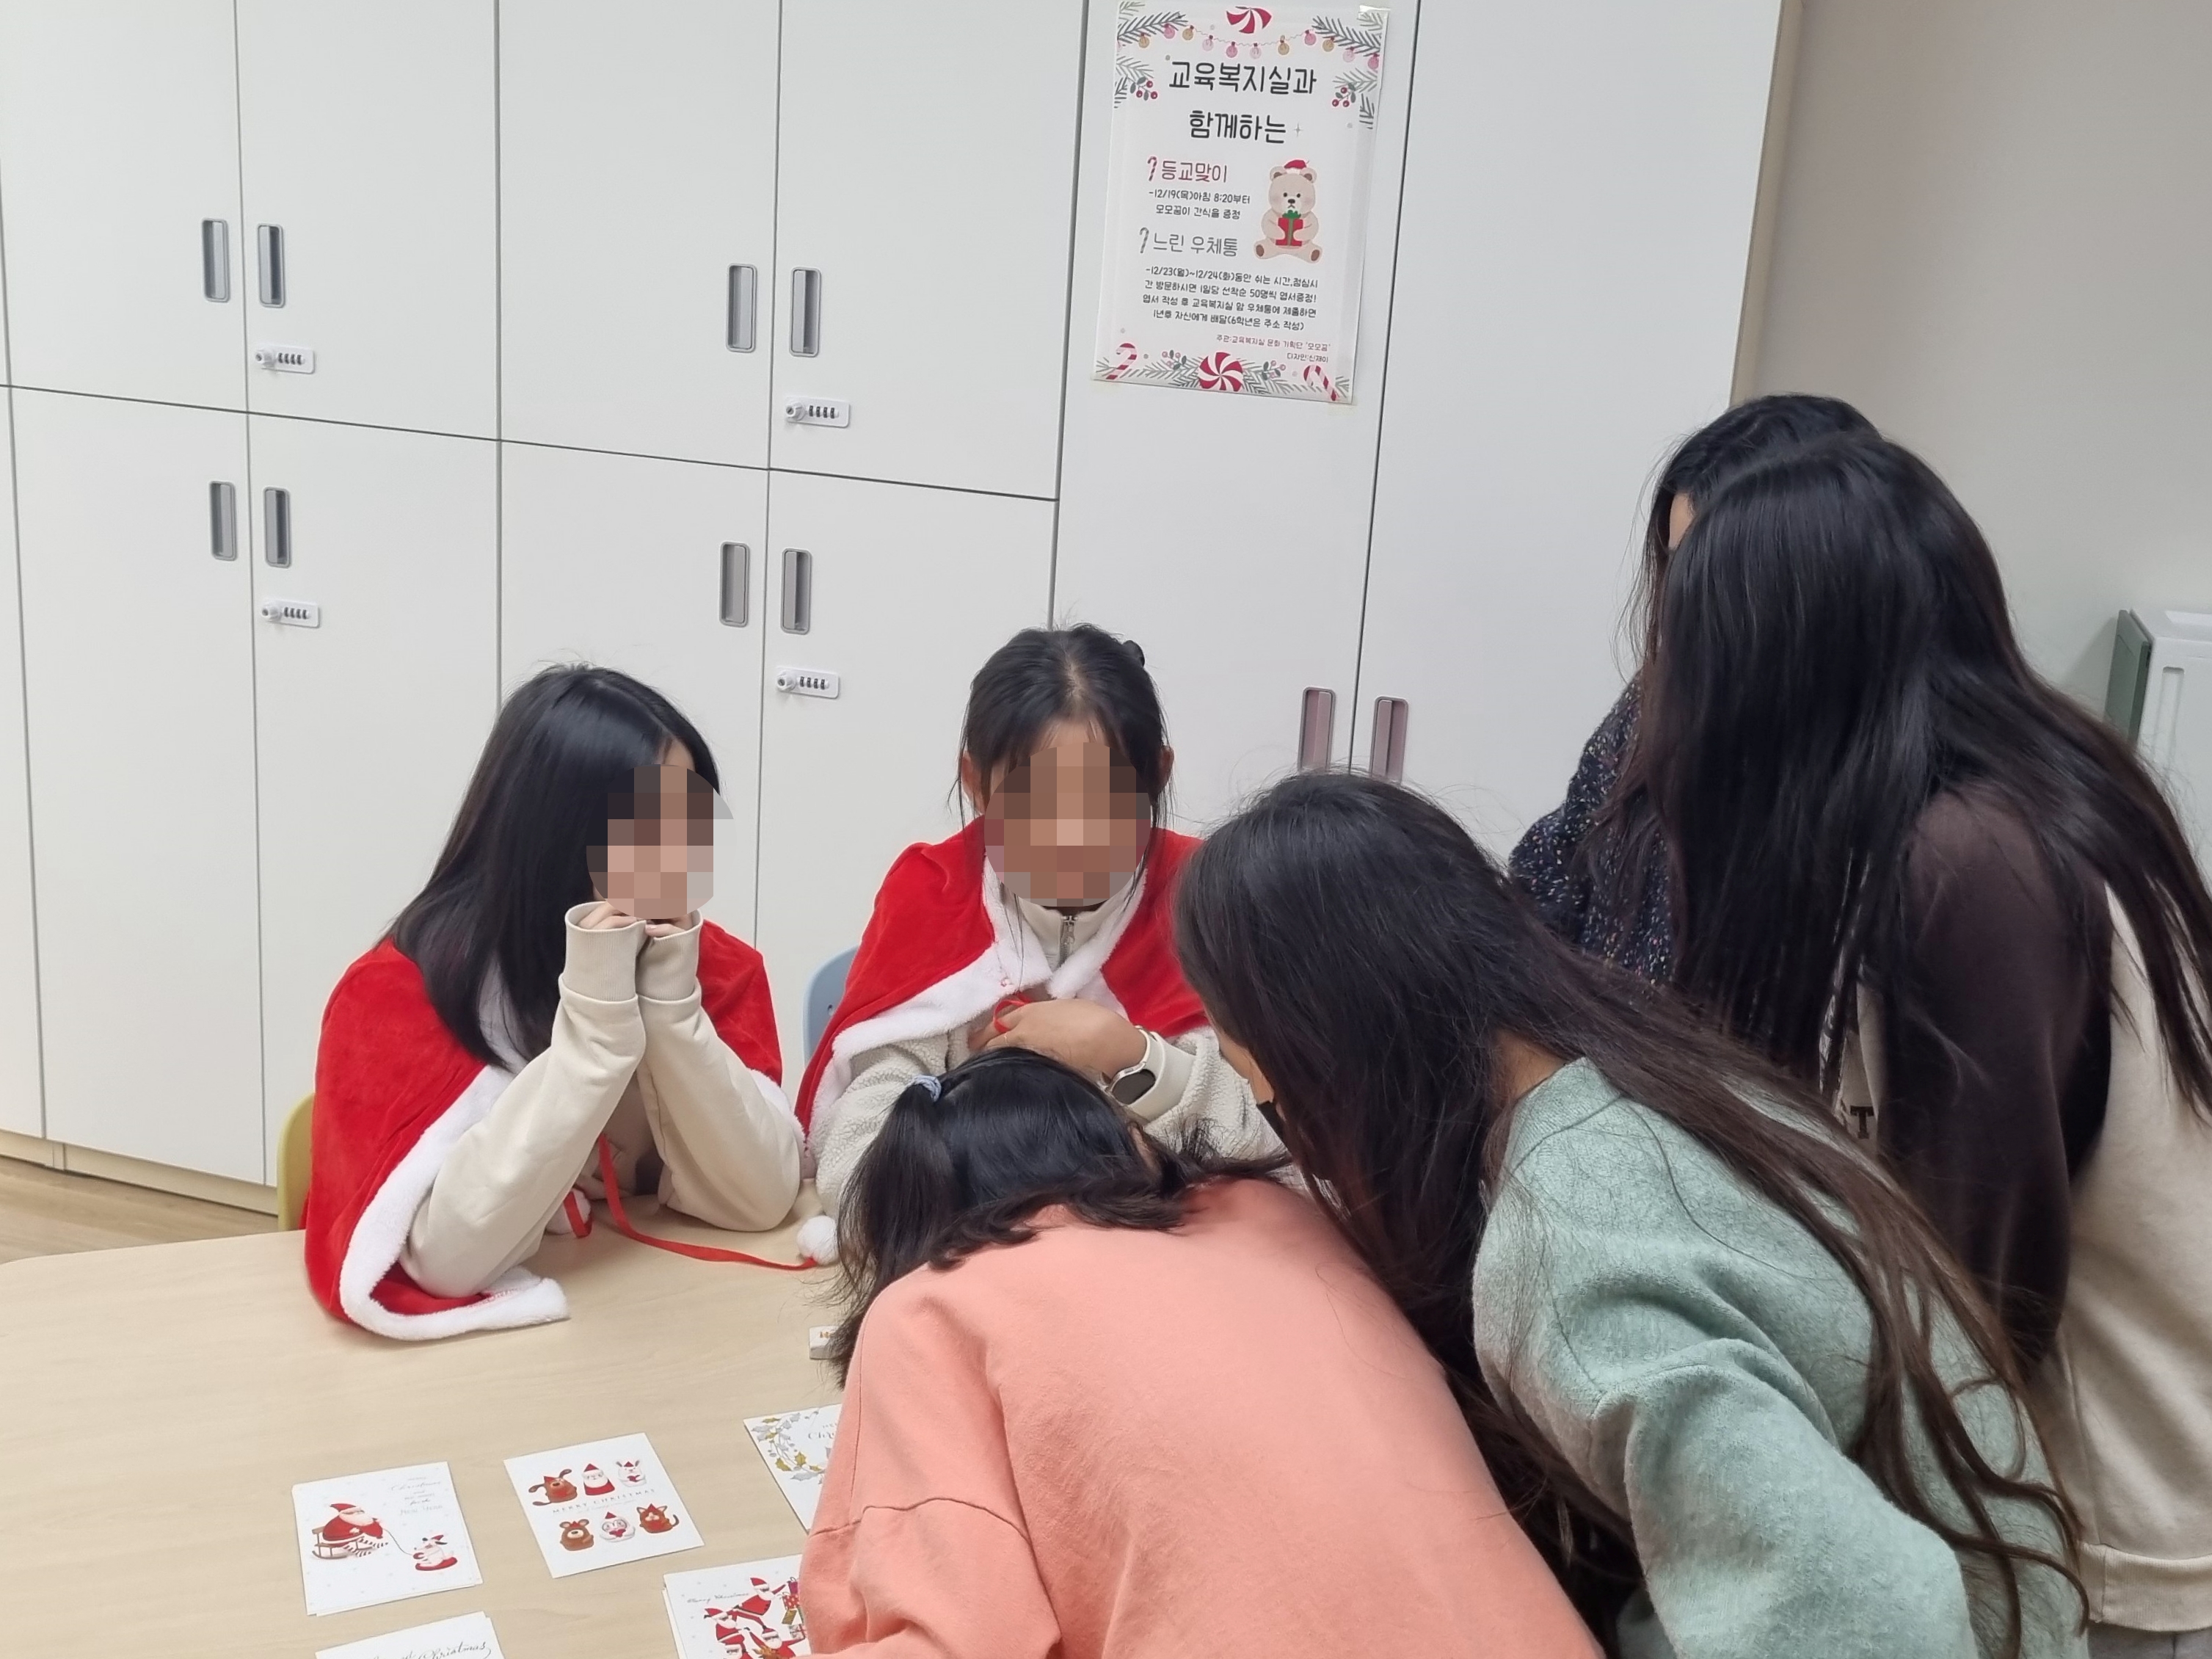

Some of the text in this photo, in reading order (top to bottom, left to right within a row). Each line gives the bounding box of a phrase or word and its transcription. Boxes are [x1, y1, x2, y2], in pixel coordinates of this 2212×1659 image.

[1169, 61, 1317, 95] 교육복지실과
[1190, 110, 1287, 144] 함께하는
[1162, 160, 1227, 183] 등교맞이
[1213, 192, 1251, 204] 8:20부터
[1193, 207, 1220, 218] 간식을
[1223, 209, 1240, 219] 증정
[1153, 233, 1237, 257] 느린 우체통
[1145, 280, 1317, 302] 간 방문하시면 1일당 선착순 50명씩 엽서증정!
[1255, 275, 1270, 285] 쉬는
[1143, 294, 1159, 303] 엽서
[1162, 296, 1178, 305] 작성
[1181, 297, 1188, 306] 후
[1192, 298, 1234, 311] 교육복지실
[1248, 303, 1281, 314] 우체통에
[1283, 307, 1317, 318] 제출하면
[1153, 309, 1172, 319] 1년후
[1175, 311, 1207, 322] 자신에게
[1264, 319, 1280, 329] 주소
[1283, 321, 1304, 331] 작성)
